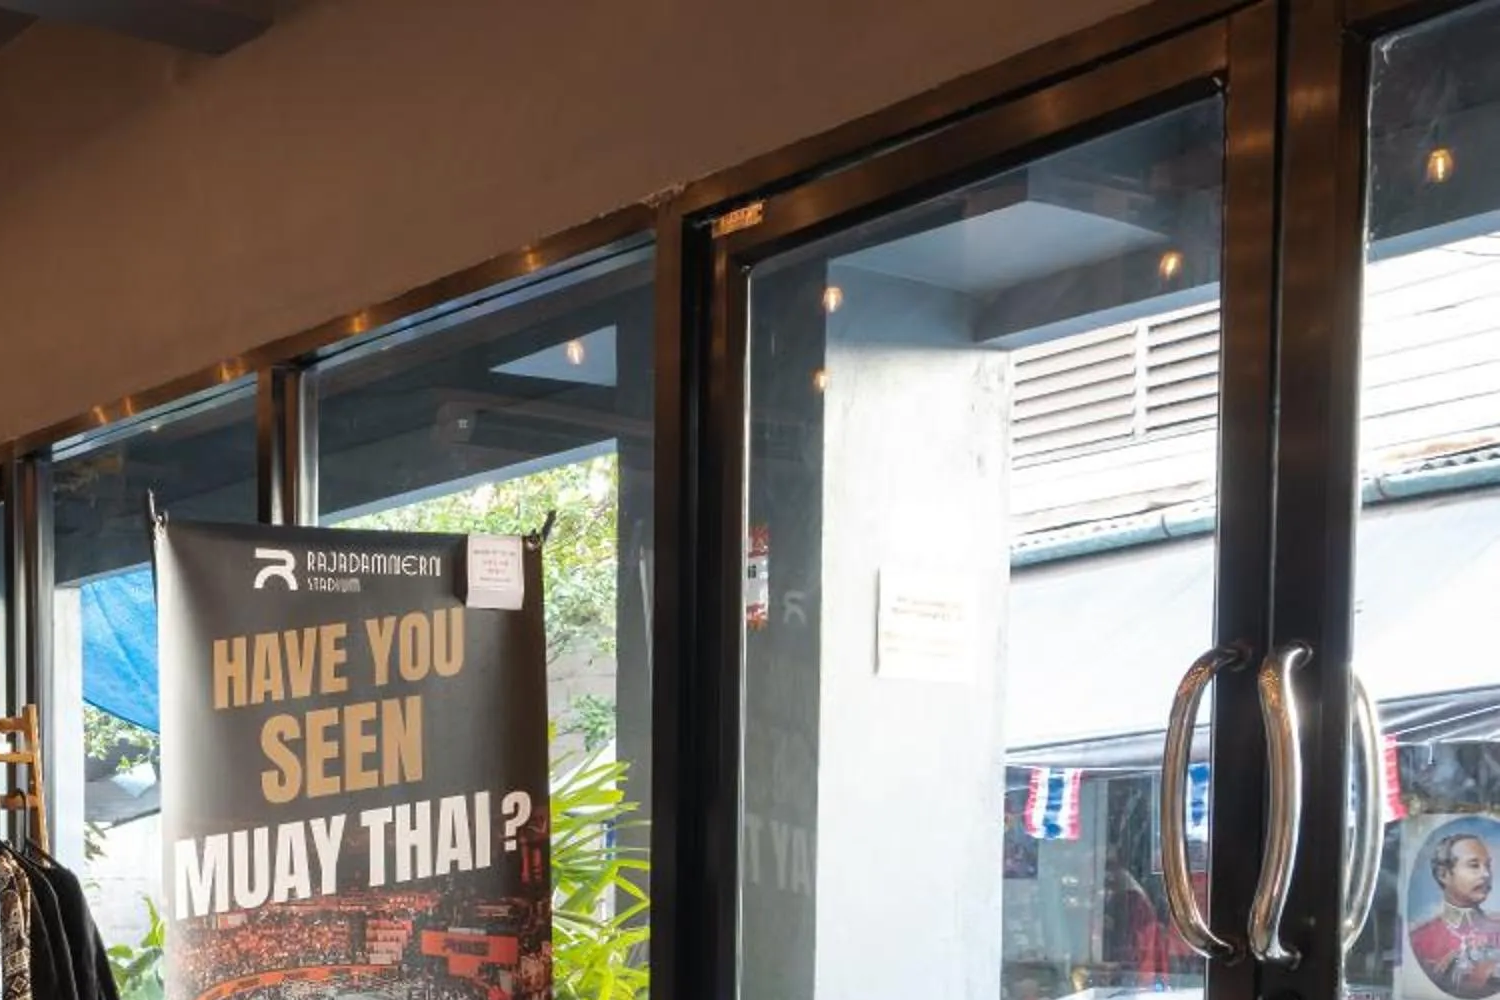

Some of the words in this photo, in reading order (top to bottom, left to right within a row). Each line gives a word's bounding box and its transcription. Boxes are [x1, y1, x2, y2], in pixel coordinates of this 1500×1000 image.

[307, 551, 442, 577] RAJADAMNERN
[307, 576, 361, 593] STADIUM
[213, 623, 347, 709] HAVE
[365, 606, 465, 687] YOU
[261, 696, 423, 804] SEEN
[174, 814, 346, 920] MUAY
